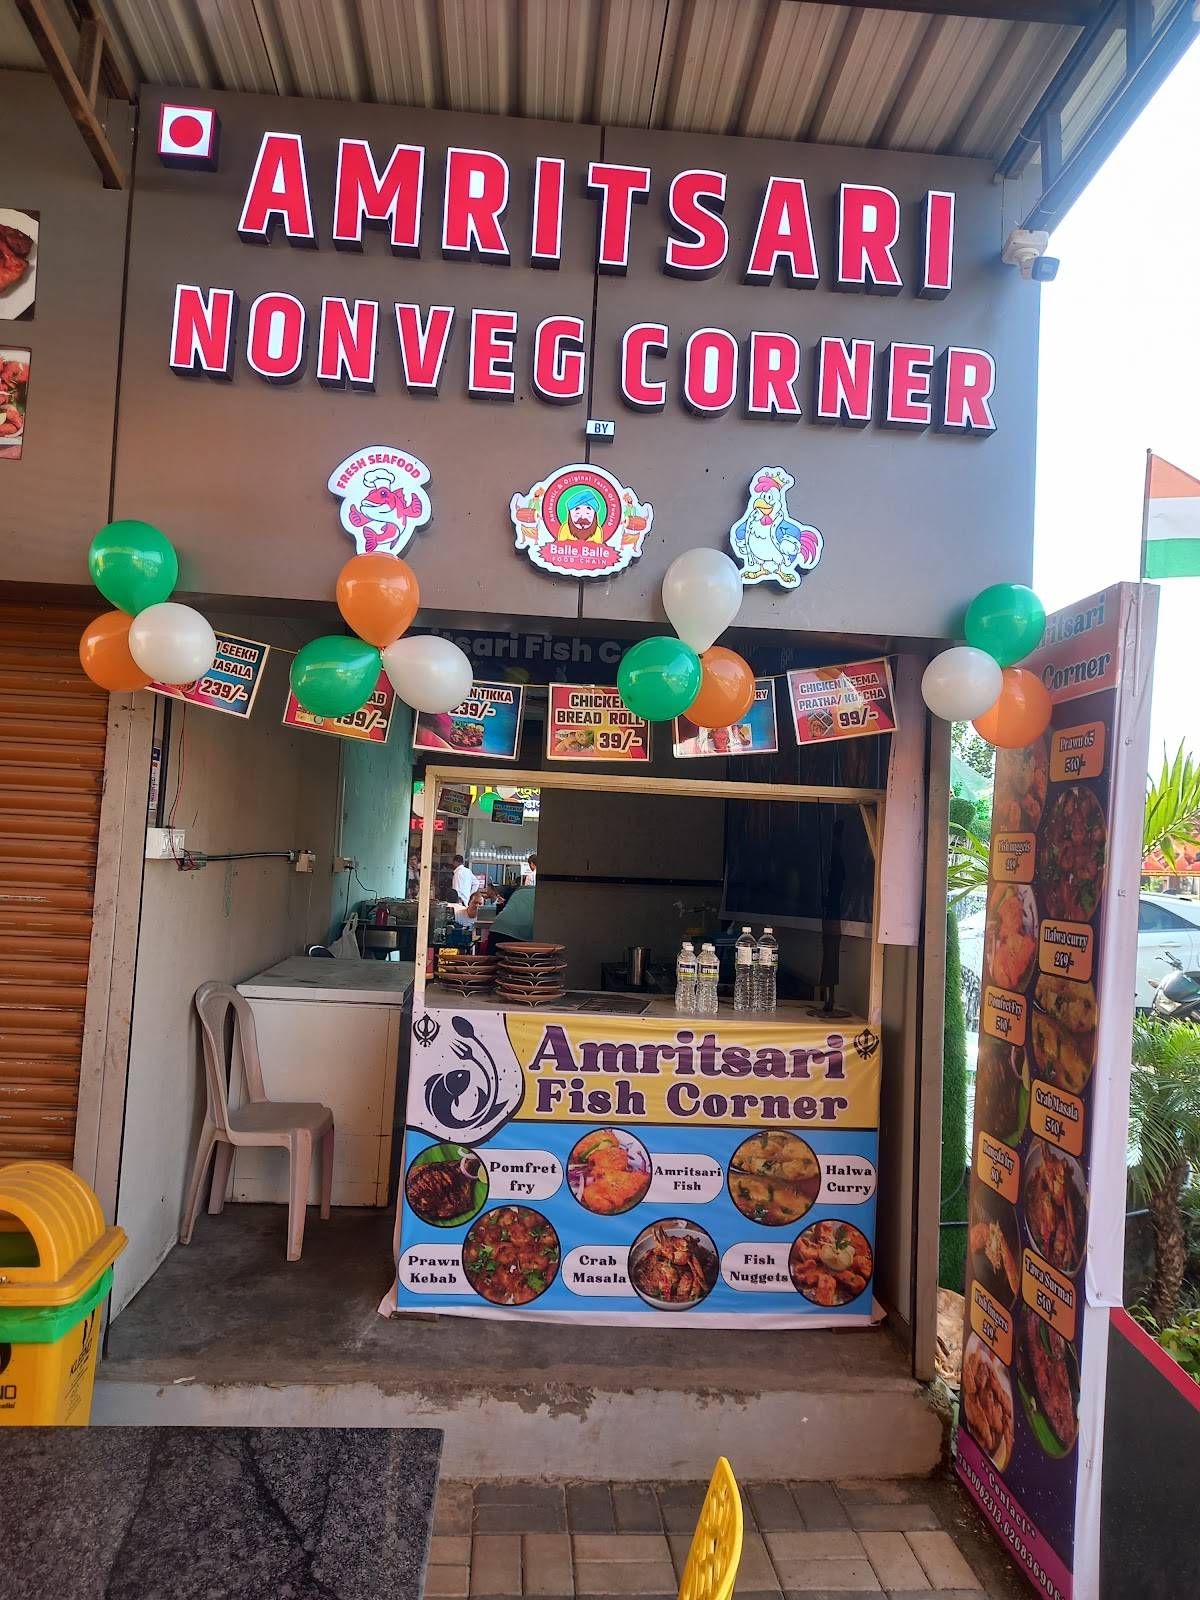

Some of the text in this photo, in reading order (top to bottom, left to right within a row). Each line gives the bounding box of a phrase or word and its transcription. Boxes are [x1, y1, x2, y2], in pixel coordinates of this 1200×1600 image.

[237, 131, 956, 291] AMRITSARI
[169, 283, 997, 430] NONVEG CORNER
[594, 421, 609, 435] BY
[336, 453, 421, 489] FRESH SEAFOOD
[563, 476, 592, 485] Original
[593, 478, 609, 493] Taste
[549, 544, 610, 558] Balle Balle
[551, 556, 608, 566] FOOD CHAIN
[221, 642, 258, 662] SEEKH
[525, 632, 592, 663] Fish
[1041, 652, 1111, 691] Corner
[200, 679, 247, 702] 239/-
[800, 678, 842, 694] CHICKEN
[479, 688, 514, 703] TIKKA
[556, 710, 644, 726] BREAD ROLL
[838, 706, 878, 728] 99/-
[599, 731, 641, 751] 39/-
[1059, 733, 1084, 753] Prawn
[529, 1025, 846, 1080] Amritsari
[535, 1078, 848, 1120] Fish Corner
[489, 1161, 557, 1174] Pomfret
[654, 1165, 722, 1179] Amritsari
[825, 1165, 873, 1177] Halwa
[509, 1179, 535, 1194] fry
[672, 1180, 702, 1192] Fish
[826, 1181, 872, 1197] Curry
[407, 1255, 460, 1268] Prawn
[578, 1254, 617, 1267] Crab
[743, 1254, 776, 1267] Fish
[409, 1272, 458, 1285] Kebab
[572, 1272, 628, 1285] Masala
[729, 1271, 789, 1285] Nuggets
[1043, 1272, 1073, 1307] Surmai
